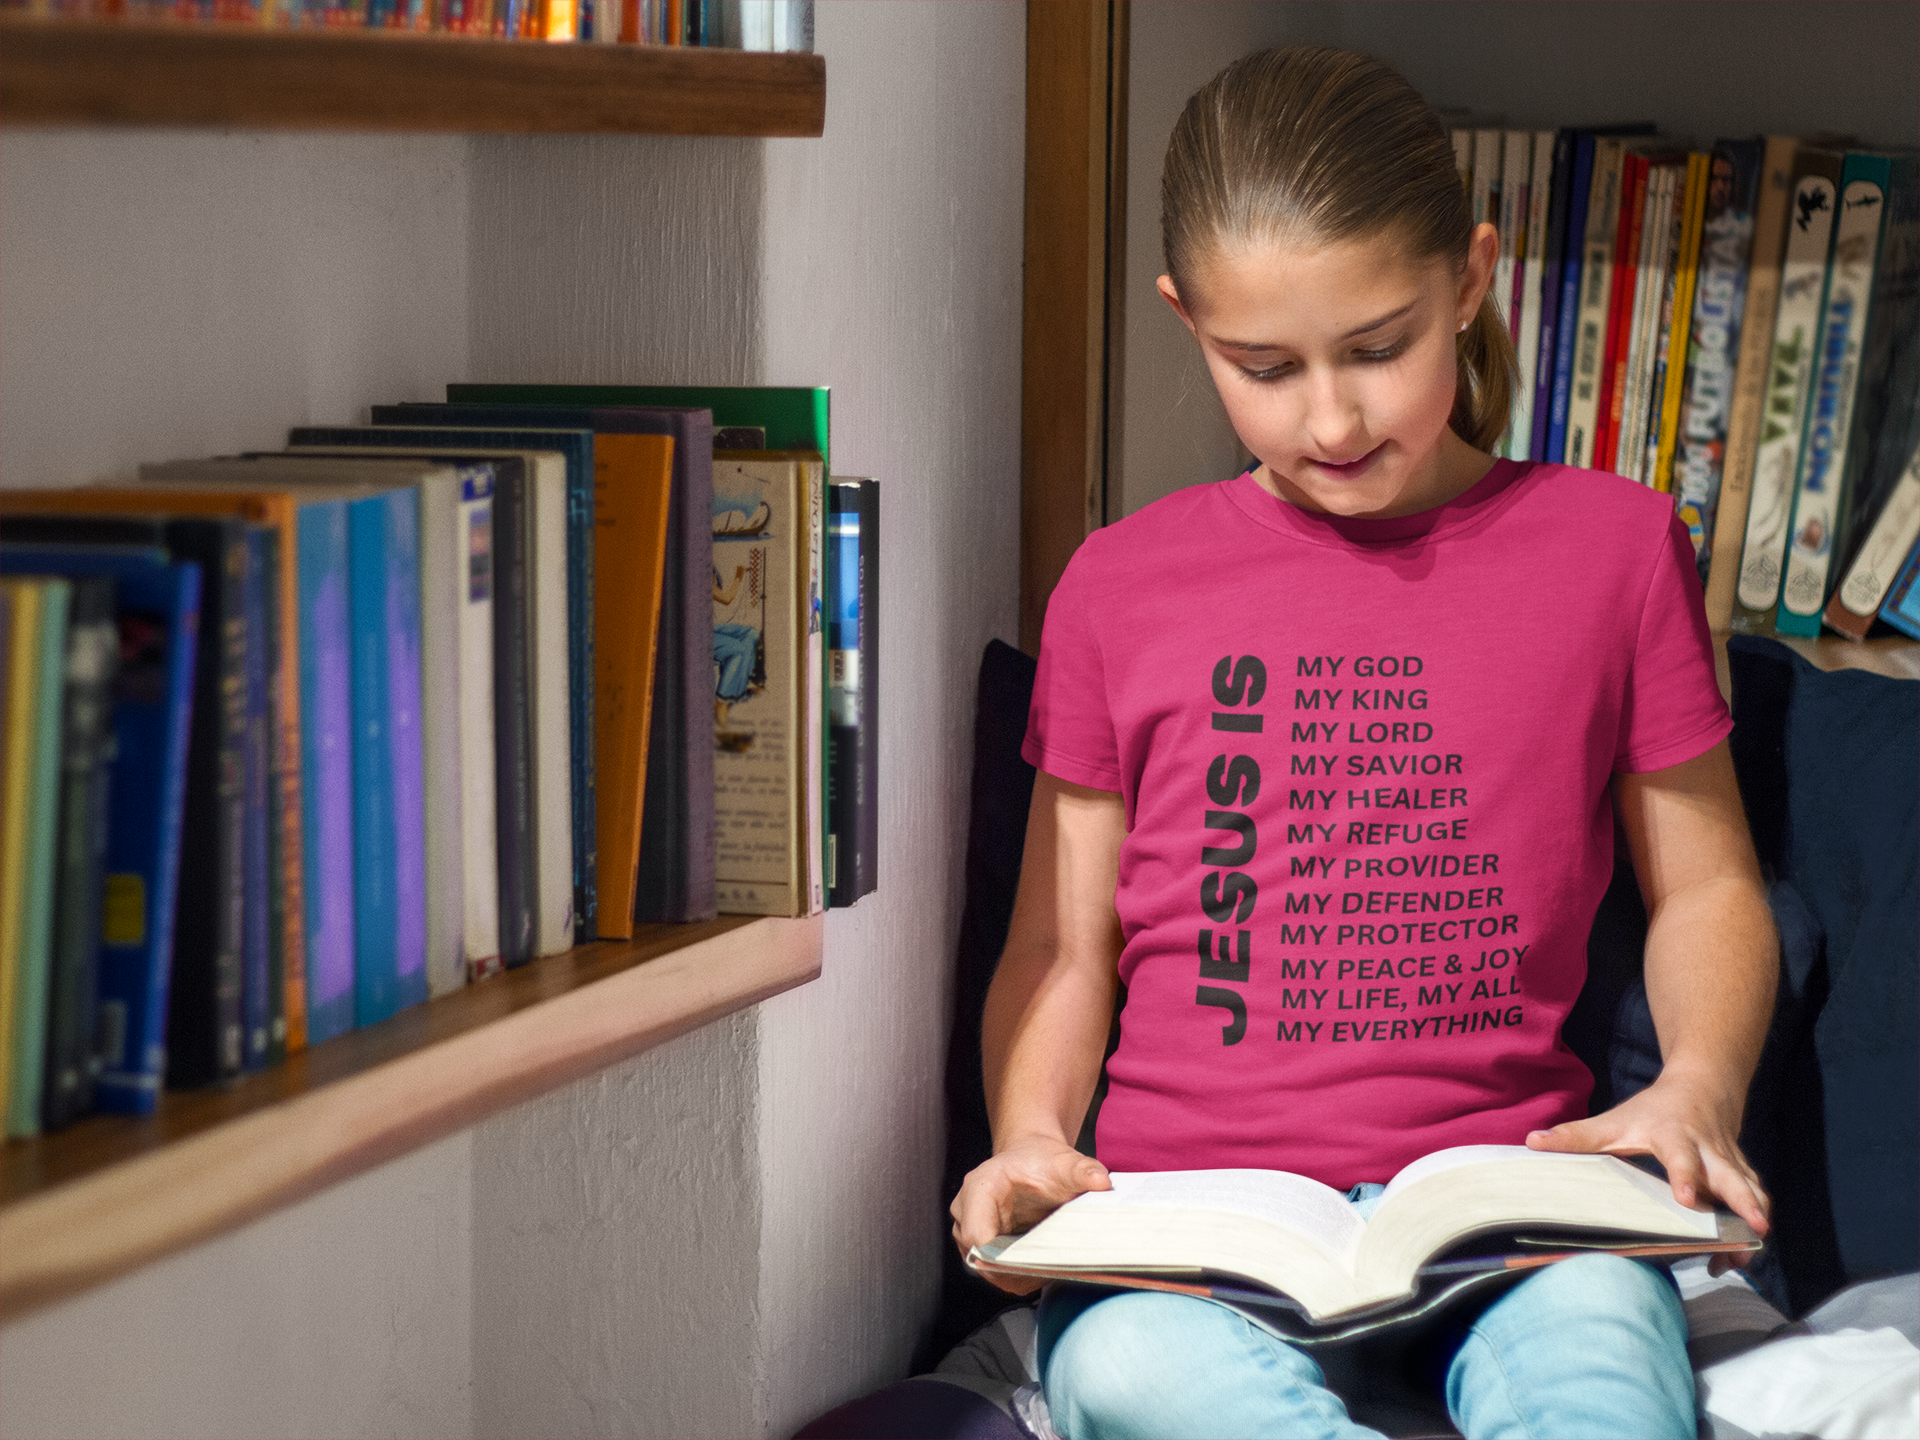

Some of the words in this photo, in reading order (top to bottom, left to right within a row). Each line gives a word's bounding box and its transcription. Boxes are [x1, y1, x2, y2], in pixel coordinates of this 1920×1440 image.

[1296, 656, 1346, 677] MY
[1353, 656, 1424, 678] GOD
[1211, 654, 1267, 734] IS
[1294, 689, 1343, 710] MY
[1352, 689, 1428, 710] KING
[1291, 721, 1340, 743] MY
[1348, 722, 1434, 744] LORD
[1290, 754, 1339, 776] MY
[1346, 754, 1463, 777] SAVIOR
[1289, 789, 1338, 811] MY
[1347, 787, 1468, 810] HEALER
[1287, 823, 1338, 844] MY
[1346, 818, 1469, 845] REFUGE
[1290, 856, 1337, 879] MY
[1344, 853, 1499, 879] PROVIDER
[1195, 753, 1261, 1047] JESUS
[1284, 892, 1333, 915] MY
[1341, 886, 1504, 915] DEFENDER
[1280, 923, 1328, 946] MY
[1337, 914, 1519, 946] PROTECTOR
[1281, 958, 1329, 980] MY
[1337, 956, 1436, 980] PEACE
[1443, 954, 1463, 975] &
[1470, 944, 1530, 972] JOY
[1281, 988, 1329, 1010] MY
[1337, 987, 1407, 1013] LIFE,
[1417, 982, 1464, 1007] MY
[1469, 975, 1523, 1001] ALL
[1276, 1020, 1324, 1043] MY
[1331, 1004, 1524, 1043] EVERYTHING
